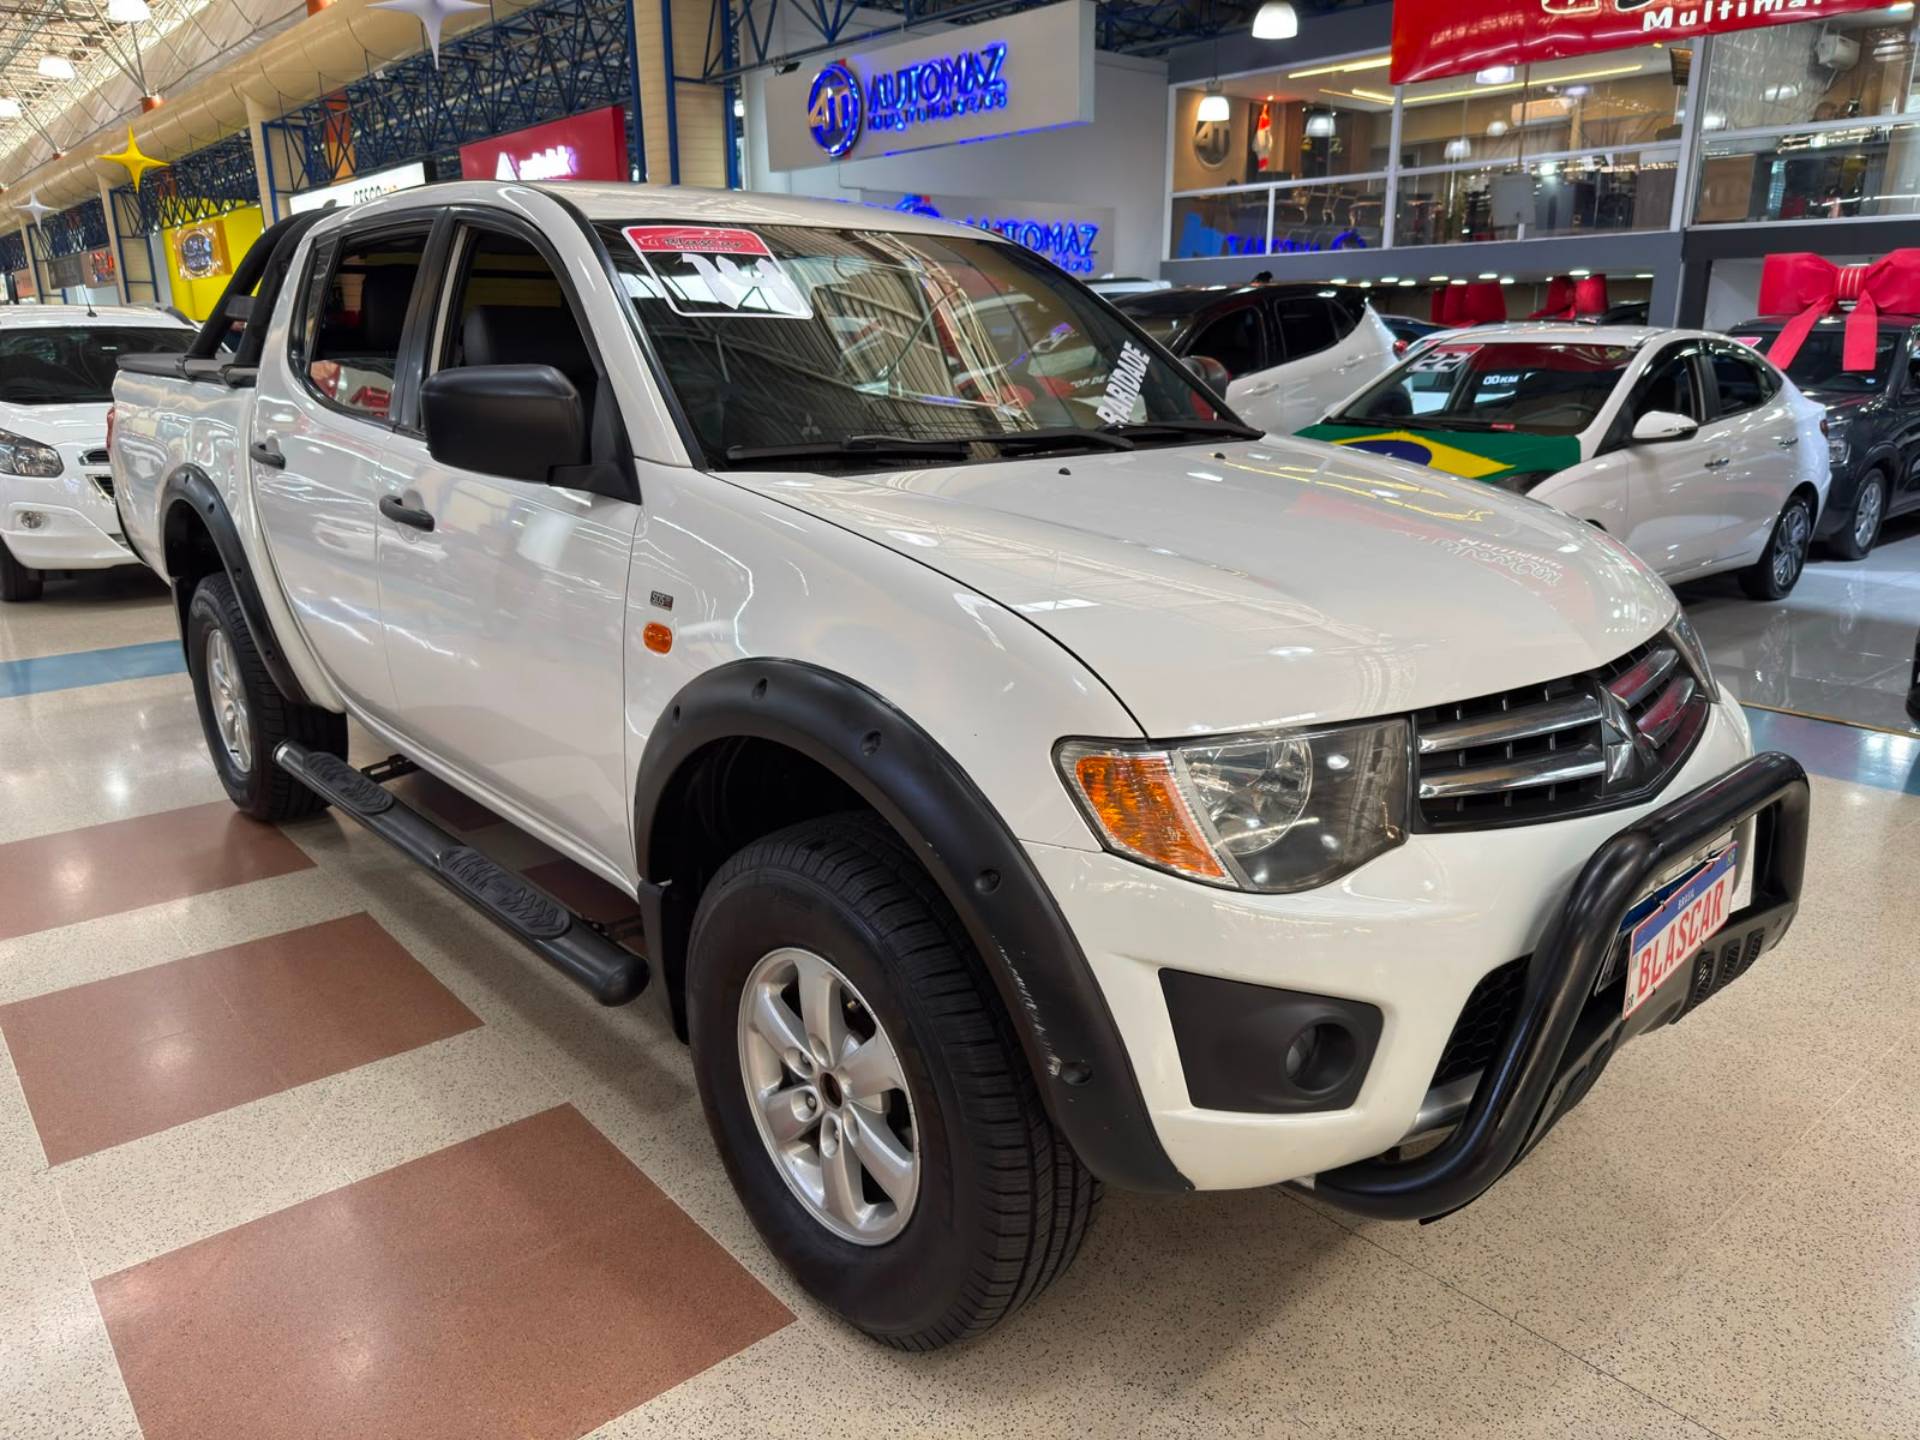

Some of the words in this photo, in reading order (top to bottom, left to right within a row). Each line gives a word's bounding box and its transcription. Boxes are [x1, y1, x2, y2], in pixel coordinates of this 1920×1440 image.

[867, 43, 1007, 112] AUTOMAZ
[1096, 340, 1150, 424] RARIDADE
[1637, 880, 1725, 998] BLASCAR
